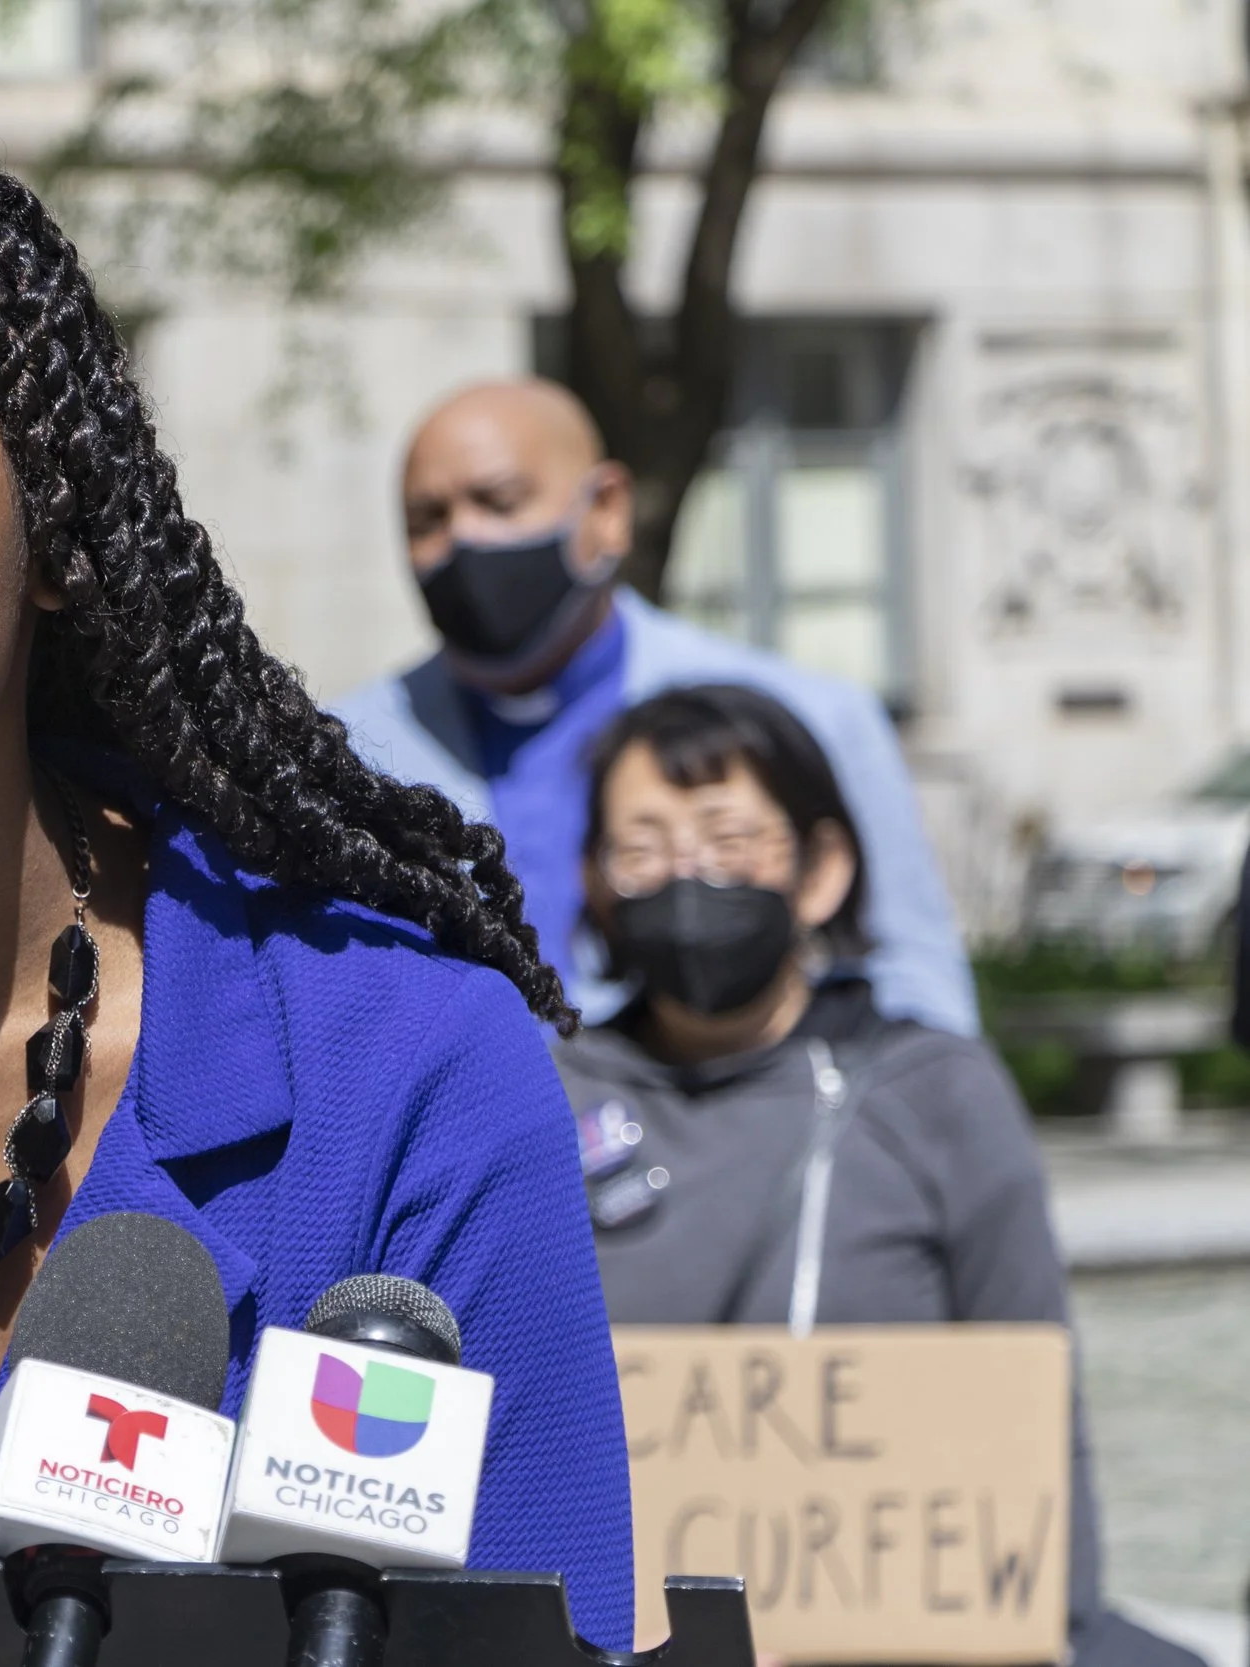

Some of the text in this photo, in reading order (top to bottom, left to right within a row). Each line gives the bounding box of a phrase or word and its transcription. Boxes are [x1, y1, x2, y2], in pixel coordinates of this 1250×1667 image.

[34, 1479, 181, 1535] CHICAGO
[39, 1458, 184, 1517] NOTICIERO
[265, 1456, 446, 1515] NOTICIAS
[275, 1485, 428, 1535] CHICAGO
[664, 1488, 1054, 1619] CURFEW
